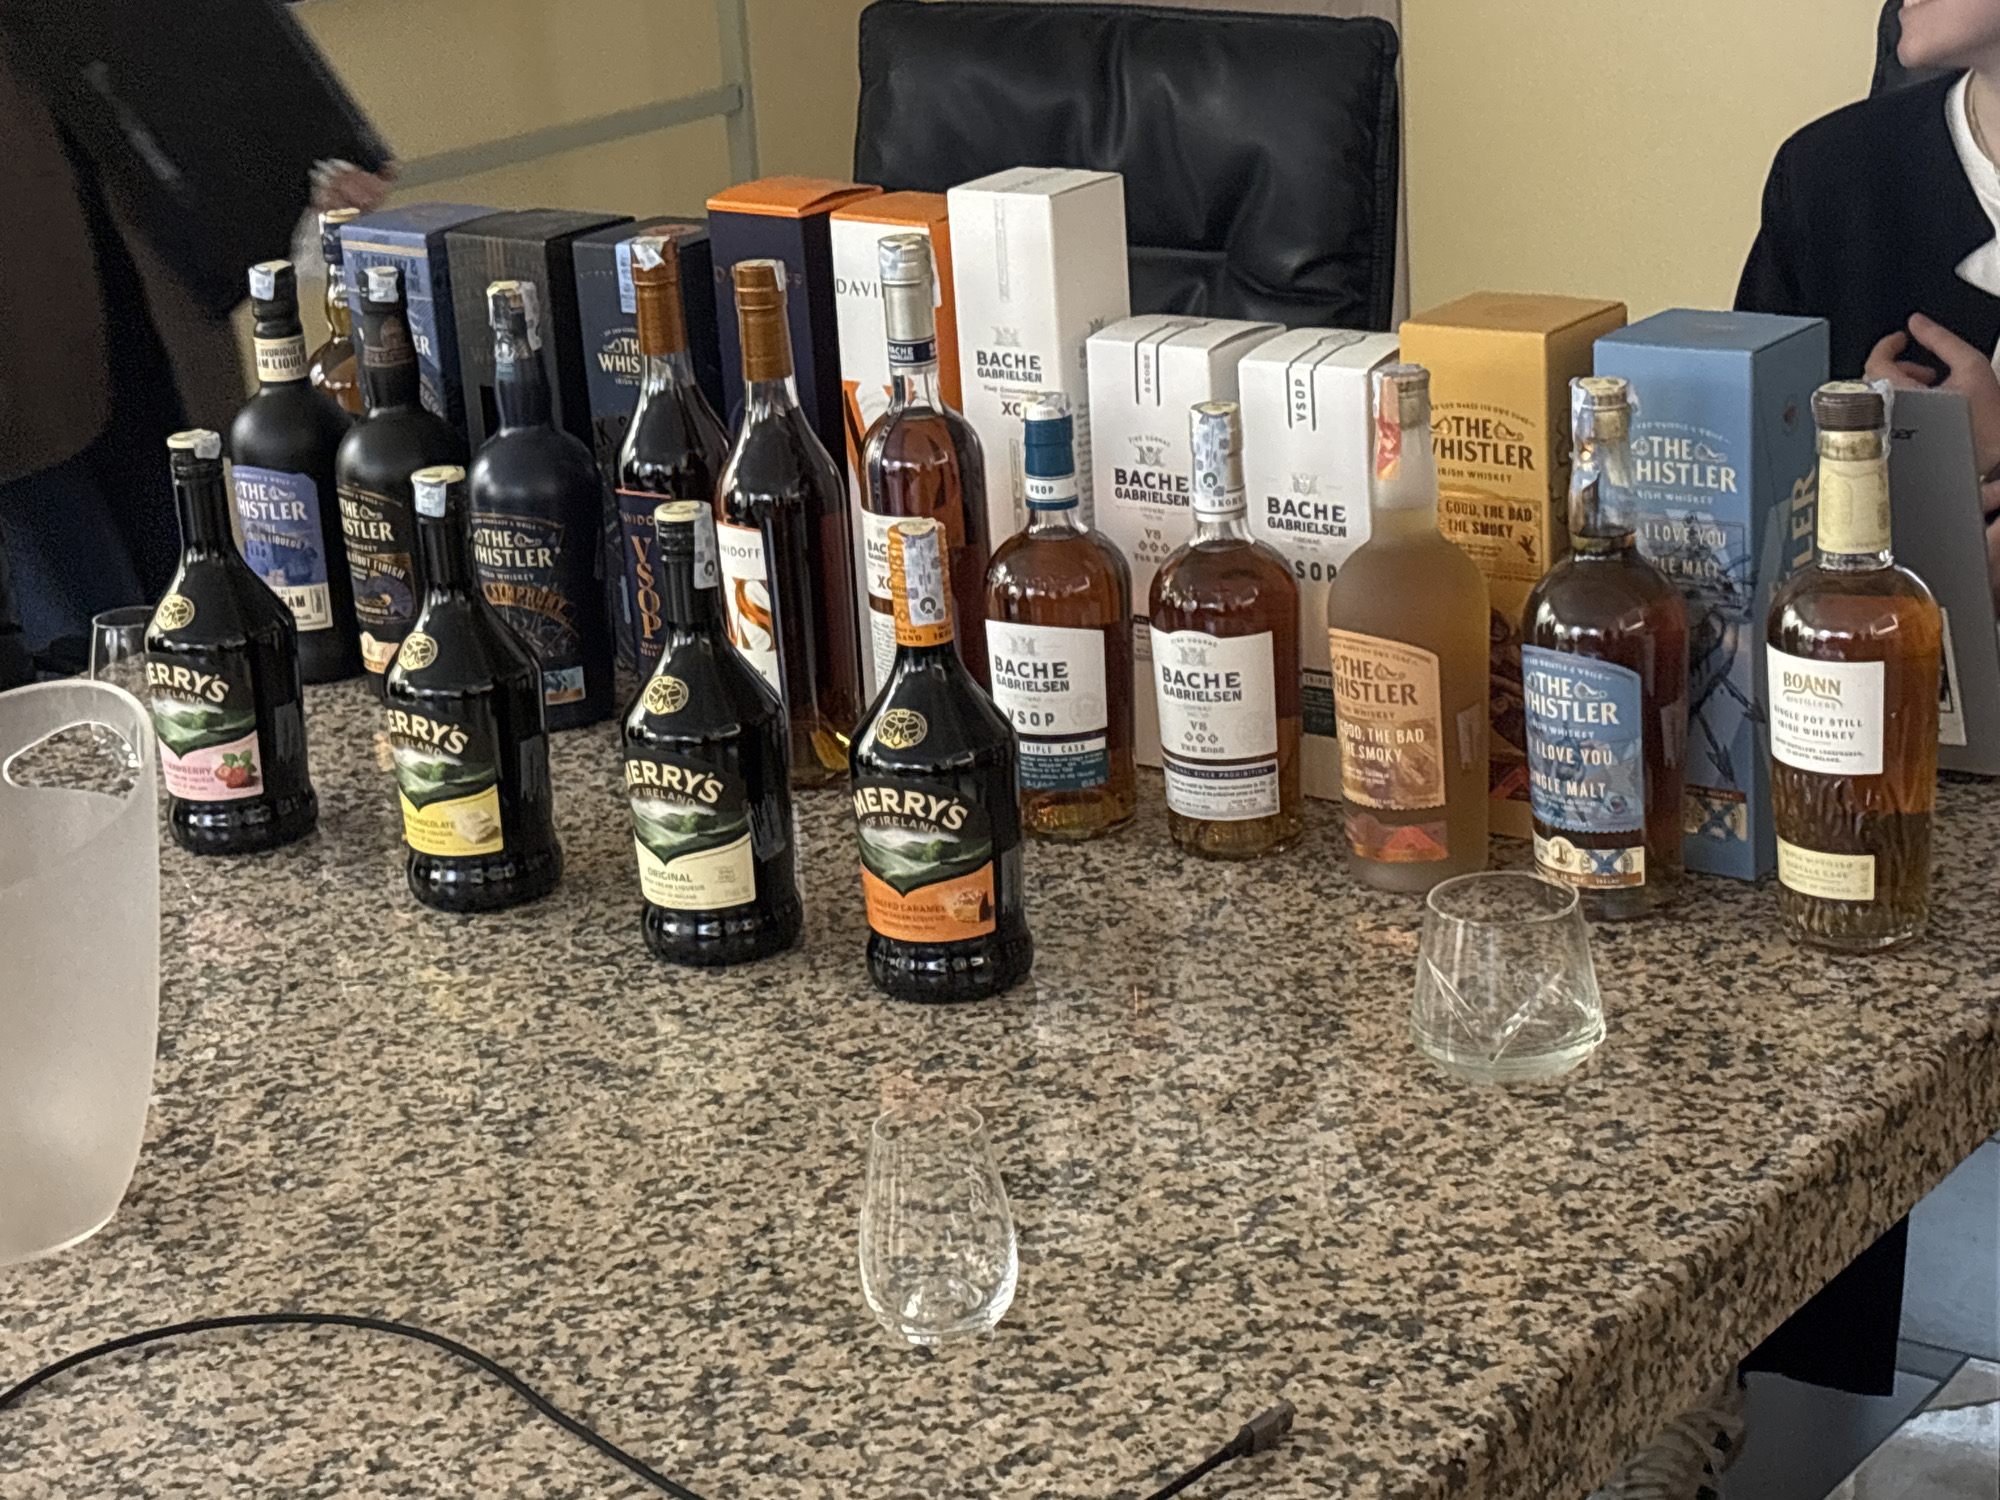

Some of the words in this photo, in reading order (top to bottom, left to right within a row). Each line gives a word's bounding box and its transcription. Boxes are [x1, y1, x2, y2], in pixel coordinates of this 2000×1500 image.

[836, 278, 878, 299] DAVI
[621, 336, 640, 355] TH
[597, 353, 641, 373] WHIS
[976, 350, 1042, 371] BACHE
[977, 367, 1042, 384] GABRIELSEN
[1295, 378, 1307, 422] VSOP
[1451, 415, 1493, 439] THE
[1648, 435, 1694, 460] THE
[1114, 467, 1189, 493] BACHE
[1467, 470, 1512, 483] WHISKEY
[1636, 459, 1738, 494] HISTLER
[240, 481, 268, 500] THE
[1030, 483, 1054, 495] VSOP
[1115, 487, 1190, 507] GABRIELSEN
[340, 497, 360, 519] THE
[1267, 496, 1347, 523] BACHE
[1483, 504, 1505, 520] THE
[1508, 506, 1532, 522] BAD
[342, 516, 395, 542] ISTLER
[482, 528, 514, 548] THE
[1267, 525, 1347, 549] GABRIELSEN
[1472, 521, 1513, 539] SMOKY
[1654, 523, 1691, 544] LOVE
[1697, 527, 1727, 548] YOU
[720, 543, 761, 559] VIDOFF
[867, 539, 887, 555] BAC
[1295, 560, 1337, 583] SOP
[995, 654, 1069, 680] BACHE
[1161, 664, 1241, 689] BACHE
[1340, 655, 1374, 680] THE
[146, 662, 230, 702] ERRY'S
[996, 673, 1070, 693] GABRIELSEN
[1163, 683, 1242, 702] GABRIELSEN
[1334, 673, 1418, 706] HISTLER
[1536, 671, 1573, 698] THE
[1783, 671, 1841, 697] BOANN
[1007, 707, 1055, 727] VSOP
[1190, 720, 1208, 731] VS
[1774, 704, 1799, 721] SINGLE
[1803, 714, 1824, 725] POT
[1829, 717, 1863, 728] STILL
[387, 709, 469, 755] ERRY'S
[1367, 727, 1391, 744] THE
[1396, 728, 1425, 744] BAD
[1549, 725, 1595, 739] WHISKEY
[1777, 719, 1799, 733] IRISH
[1802, 726, 1855, 740] WHISKEY
[1358, 744, 1402, 763] SMOKY
[1541, 741, 1575, 765] LOVE
[1580, 749, 1613, 766] YOU
[1218, 763, 1269, 779] PROHIBITION
[642, 787, 697, 808] IRELAND
[1566, 780, 1607, 798] MALT
[853, 787, 968, 830] MERRY'S
[866, 816, 876, 828] OF
[879, 816, 940, 833] IRELAND
[647, 867, 693, 883] ORIGINAL
